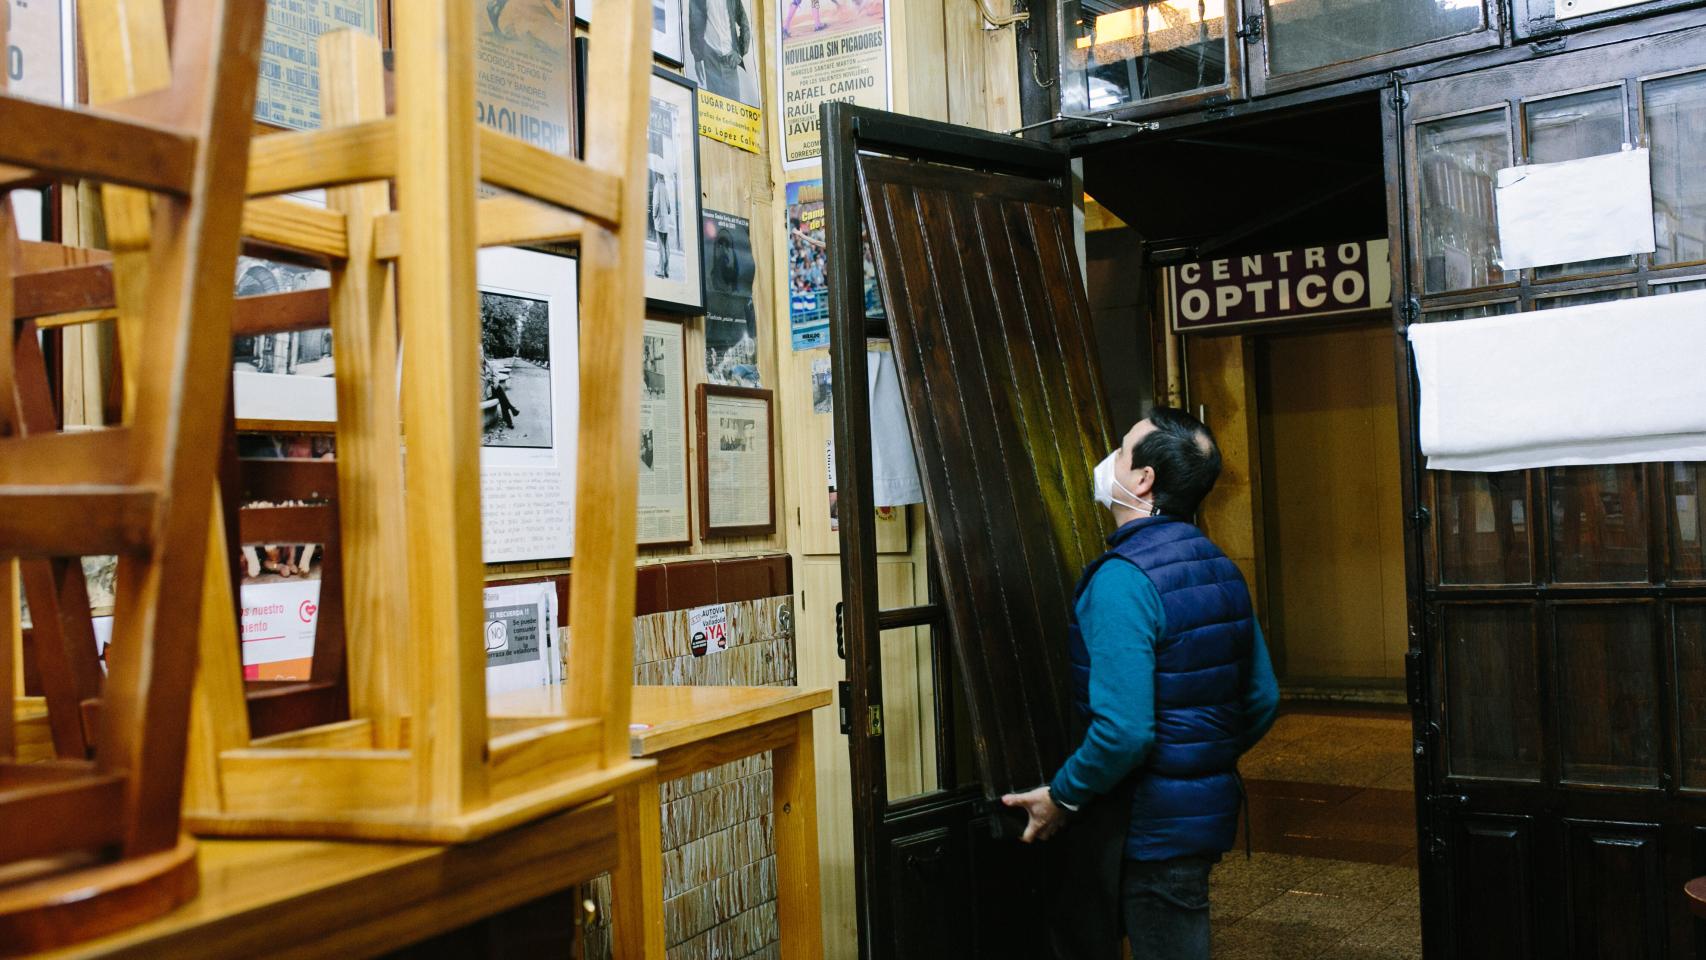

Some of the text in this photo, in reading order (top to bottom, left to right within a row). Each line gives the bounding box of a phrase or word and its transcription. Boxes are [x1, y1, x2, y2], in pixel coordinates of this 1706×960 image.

[785, 43, 825, 65] NOVILLADA
[826, 39, 839, 57] SIN
[841, 30, 883, 54] PICADORES
[786, 85, 826, 103] RAFAEL
[829, 75, 875, 95] CAMINO
[700, 93, 724, 110] LUGAR
[726, 102, 739, 115] DEL
[786, 101, 815, 118] RAÚL
[787, 119, 821, 136] JAVIE
[1180, 242, 1361, 285] CENTRO
[1180, 269, 1365, 321] OPTICO
[252, 603, 285, 615] nuestro
[705, 622, 727, 641] ¡YA!
